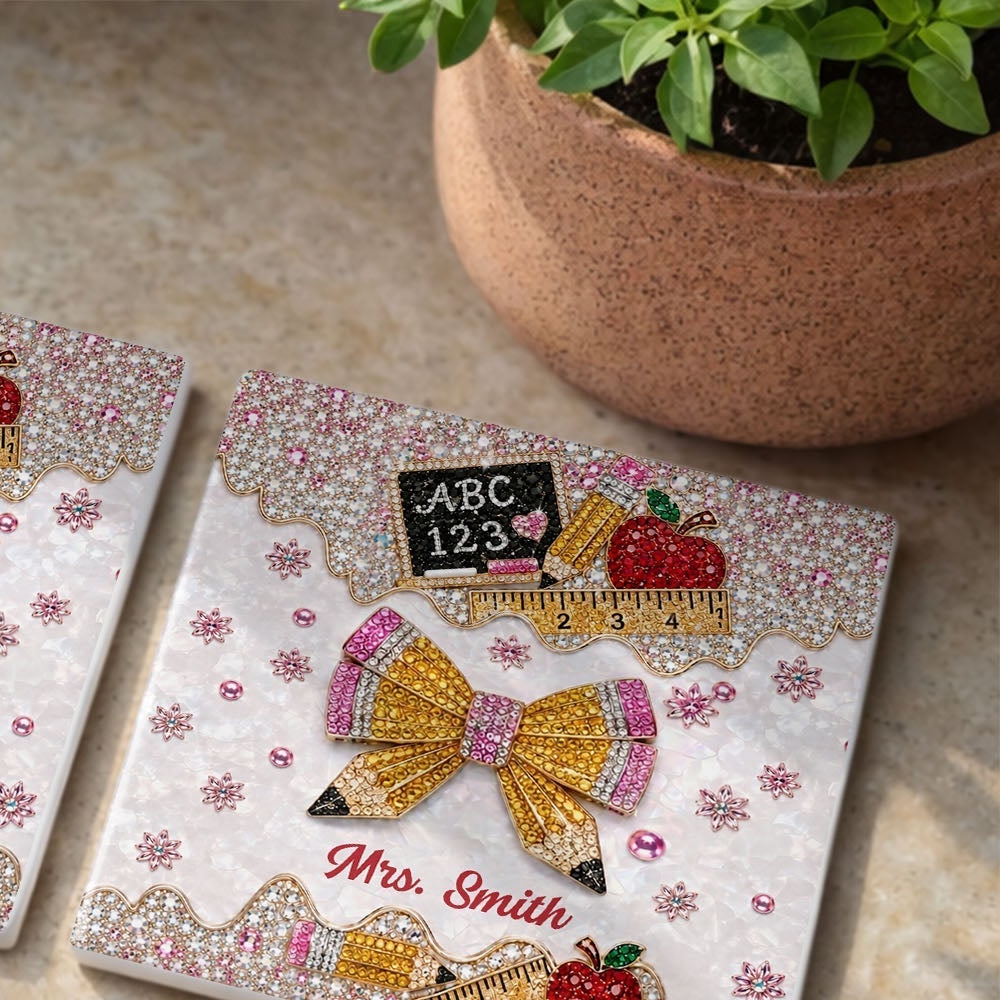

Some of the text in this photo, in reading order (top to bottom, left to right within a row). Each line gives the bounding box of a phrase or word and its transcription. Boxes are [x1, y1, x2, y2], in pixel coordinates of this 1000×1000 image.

[415, 475, 515, 514] ABC
[427, 520, 509, 556] 123
[556, 612, 679, 630] 2 3 4
[324, 843, 574, 930] Mrs. Smith
